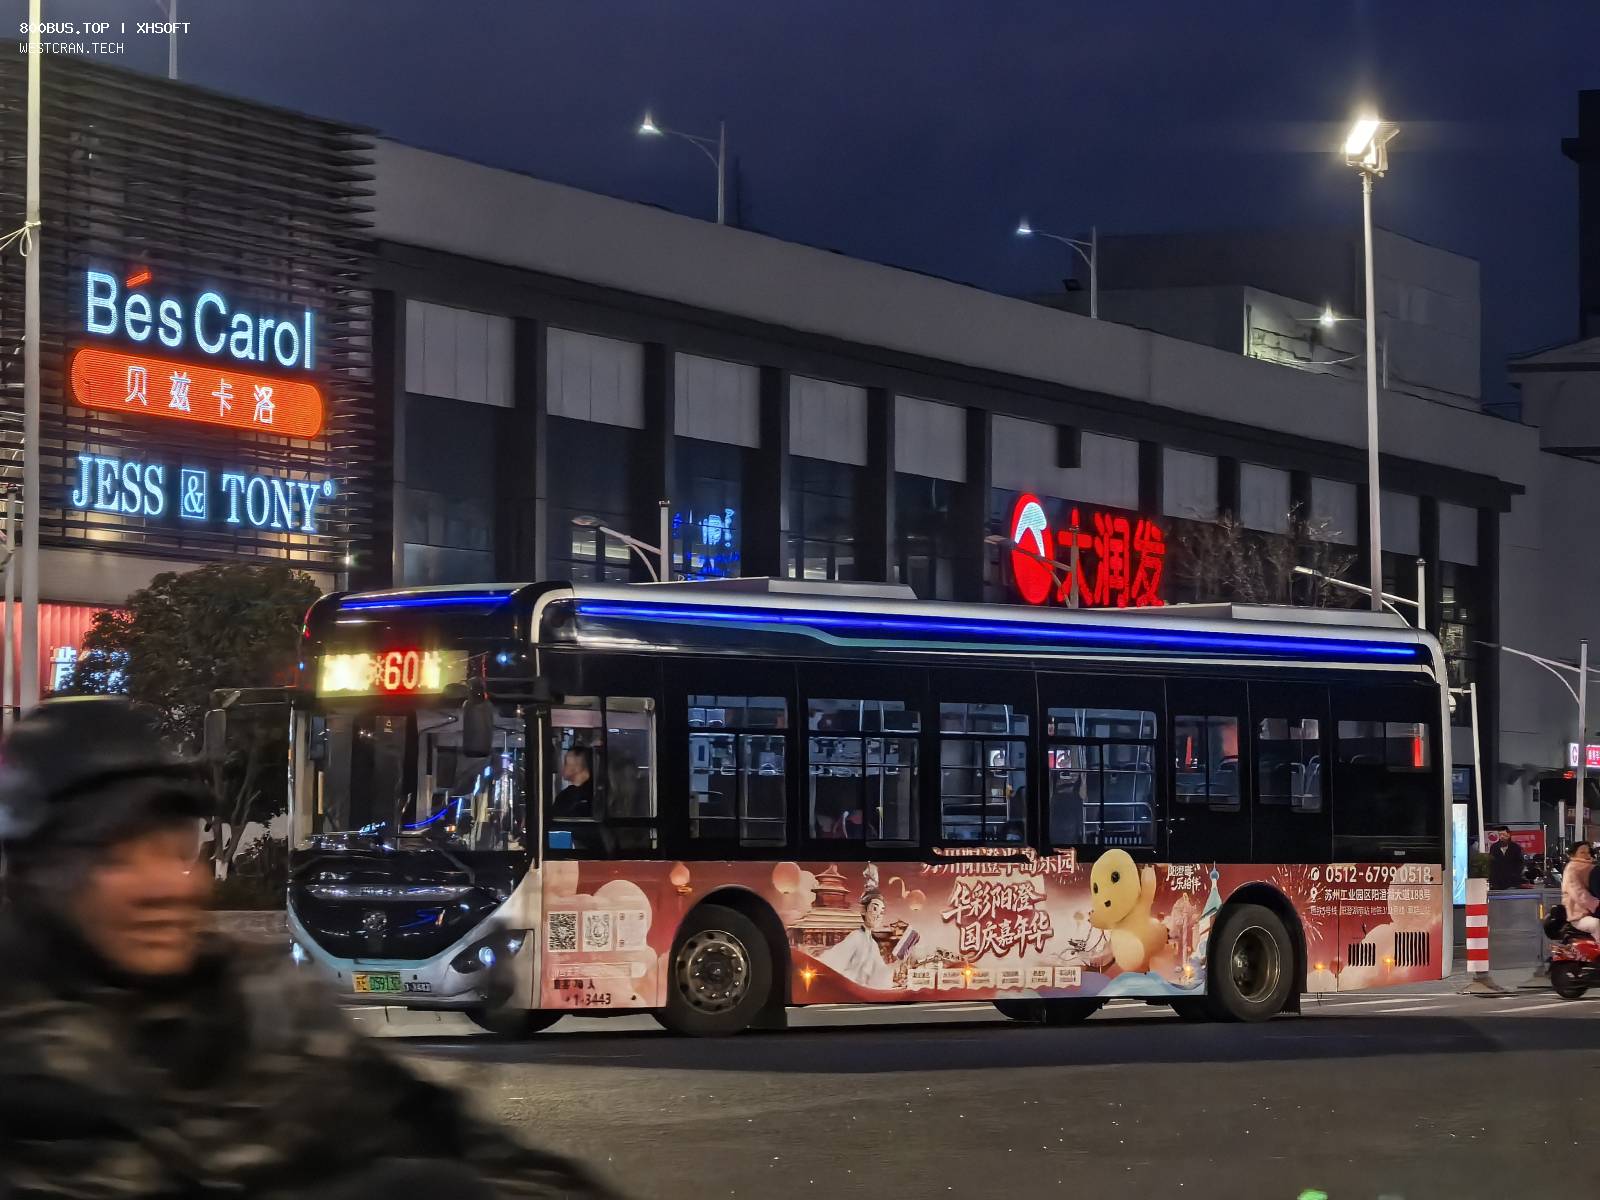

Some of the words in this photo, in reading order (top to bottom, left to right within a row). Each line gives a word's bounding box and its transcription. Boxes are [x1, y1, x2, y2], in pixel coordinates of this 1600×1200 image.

[86, 266, 183, 347] Bés
[194, 292, 313, 369] Carol
[125, 366, 276, 424] 贝兹卡洛
[72, 455, 164, 515] JESS
[183, 474, 205, 514] &
[1057, 507, 1165, 608] 大润发
[943, 882, 1046, 922] 华彩阳澄
[960, 912, 1053, 958] 国庆嘉年华
